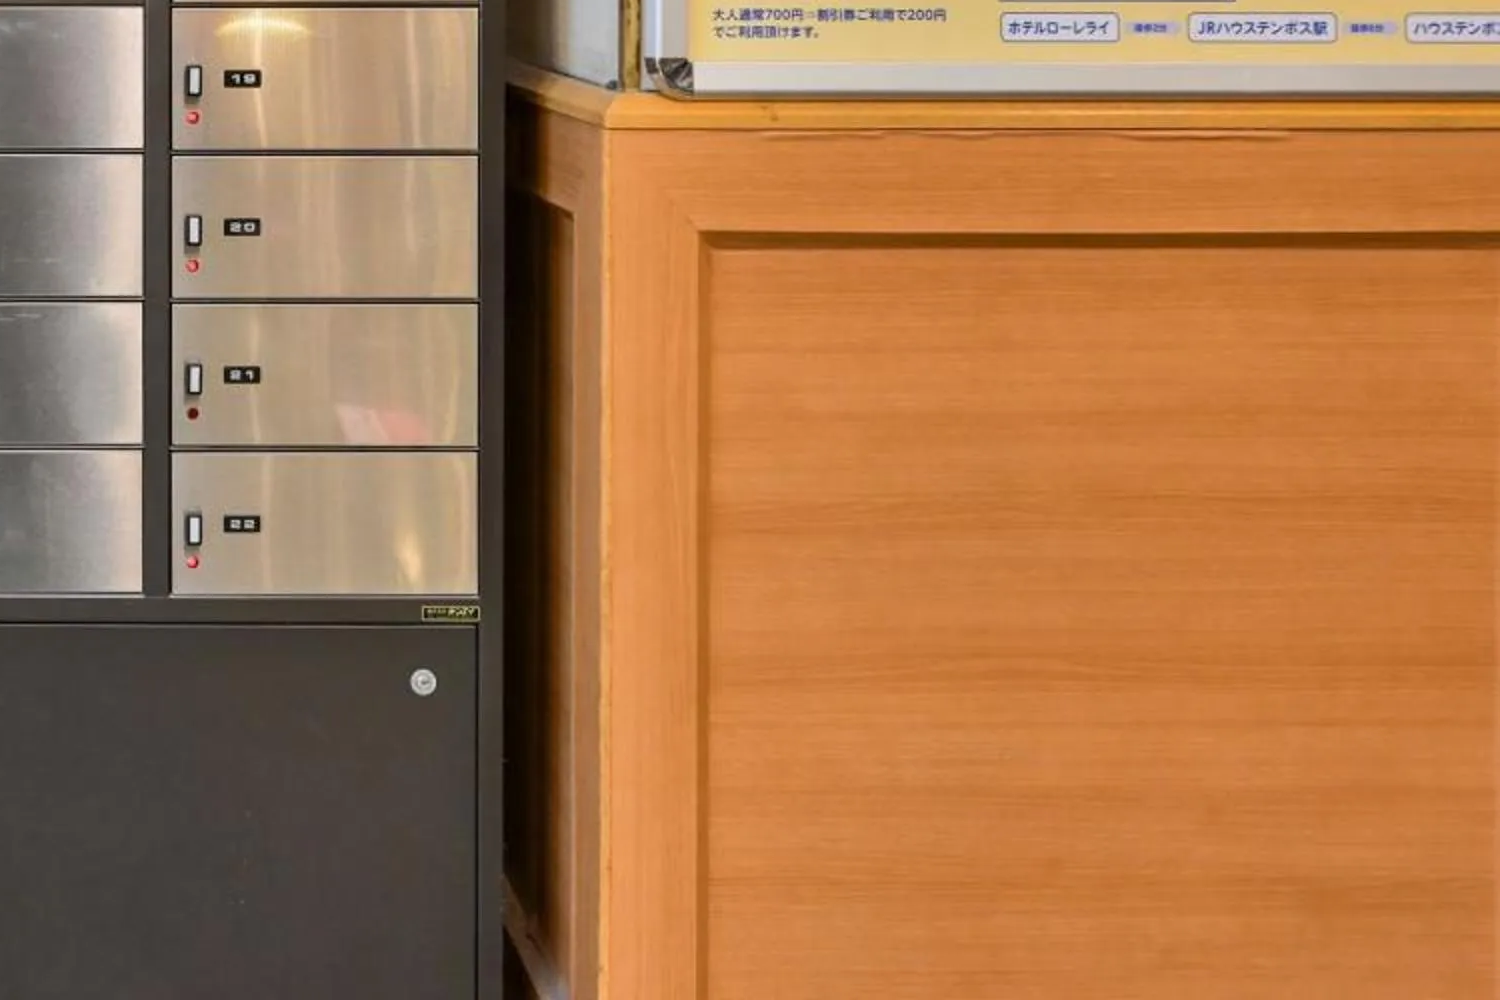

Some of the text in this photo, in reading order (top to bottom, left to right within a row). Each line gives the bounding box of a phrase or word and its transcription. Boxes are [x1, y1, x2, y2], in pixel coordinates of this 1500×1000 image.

[1008, 21, 1110, 35] ホテルローレライ
[1197, 21, 1329, 36] JRハウステンボス駅
[231, 73, 257, 84] 19
[230, 221, 256, 233] 20
[230, 369, 255, 380] 21
[230, 518, 255, 529] 22
